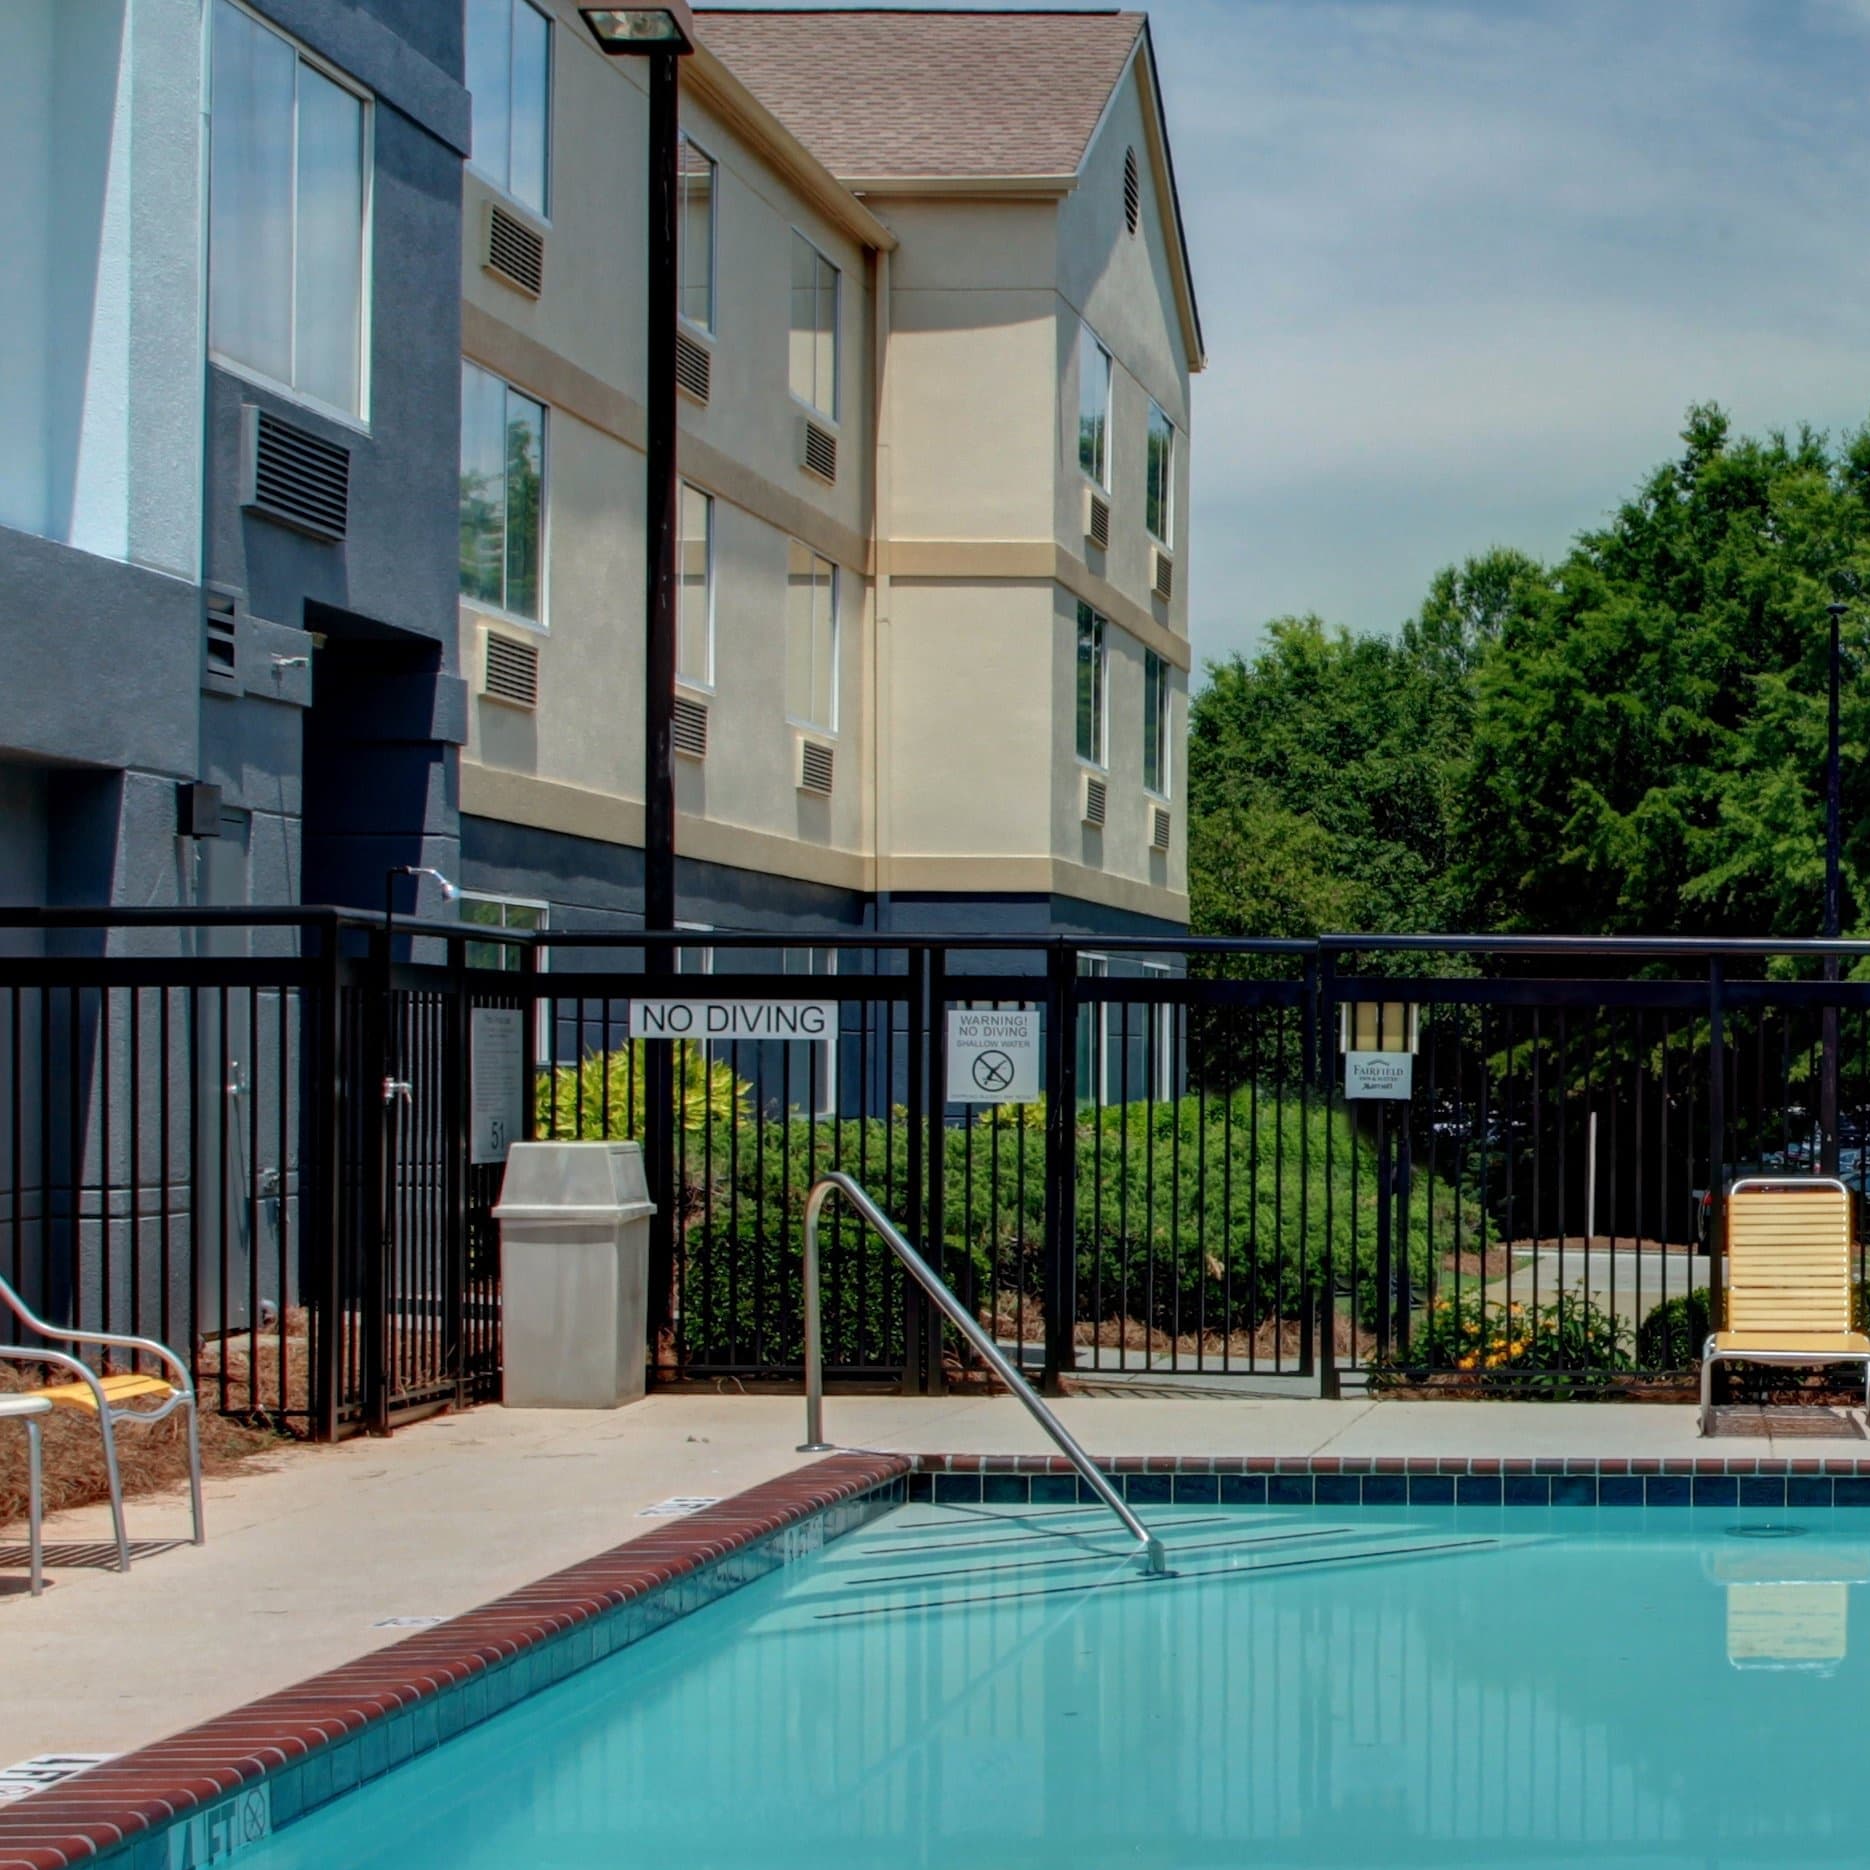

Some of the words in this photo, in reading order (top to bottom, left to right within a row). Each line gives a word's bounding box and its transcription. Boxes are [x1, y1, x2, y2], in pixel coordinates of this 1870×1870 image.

[643, 1004, 693, 1033] NO
[707, 1005, 825, 1033] DIVING
[959, 1026, 978, 1037] NO
[983, 1026, 1028, 1038] DIVING
[960, 1015, 1028, 1026] WARNING!
[491, 1121, 504, 1151] 51
[208, 1799, 236, 1867] FT
